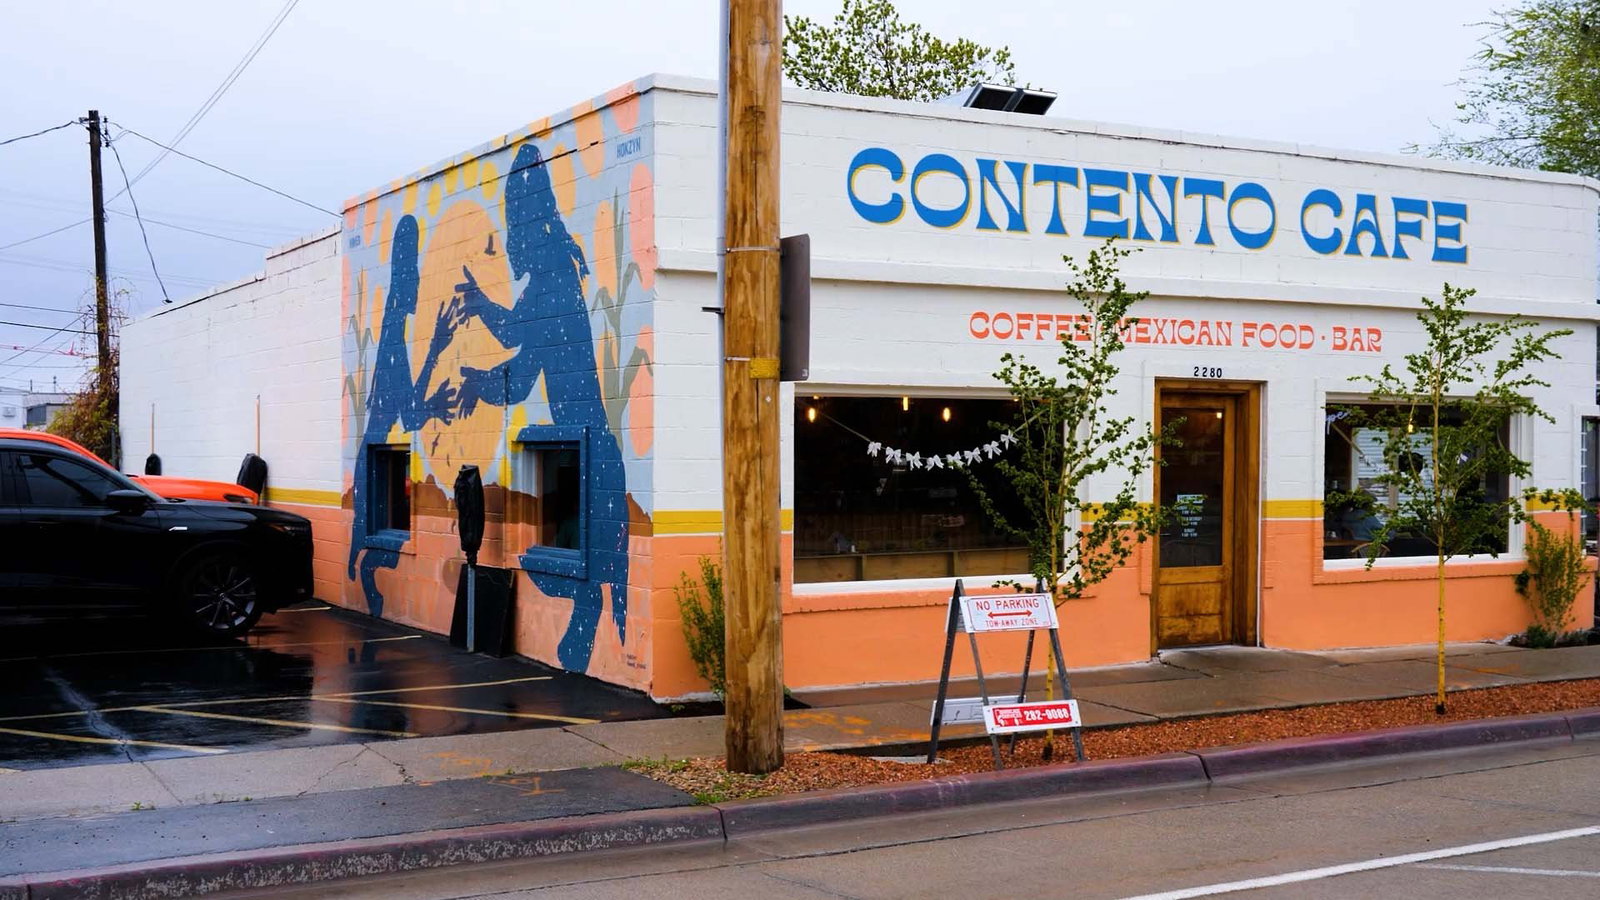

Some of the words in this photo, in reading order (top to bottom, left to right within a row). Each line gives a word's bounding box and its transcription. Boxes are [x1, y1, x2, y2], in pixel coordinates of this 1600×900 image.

[847, 147, 1276, 250] CONTENTO
[1300, 188, 1468, 264] CAFE
[970, 311, 1092, 341] COFFEE
[1114, 318, 1233, 346] MEXICAN
[1242, 322, 1315, 349] FOOD
[1331, 325, 1382, 352] BAR
[1194, 366, 1222, 378] 2280
[976, 602, 990, 611] NO
[996, 599, 1039, 609] PARKING
[1021, 617, 1039, 626] ZONE
